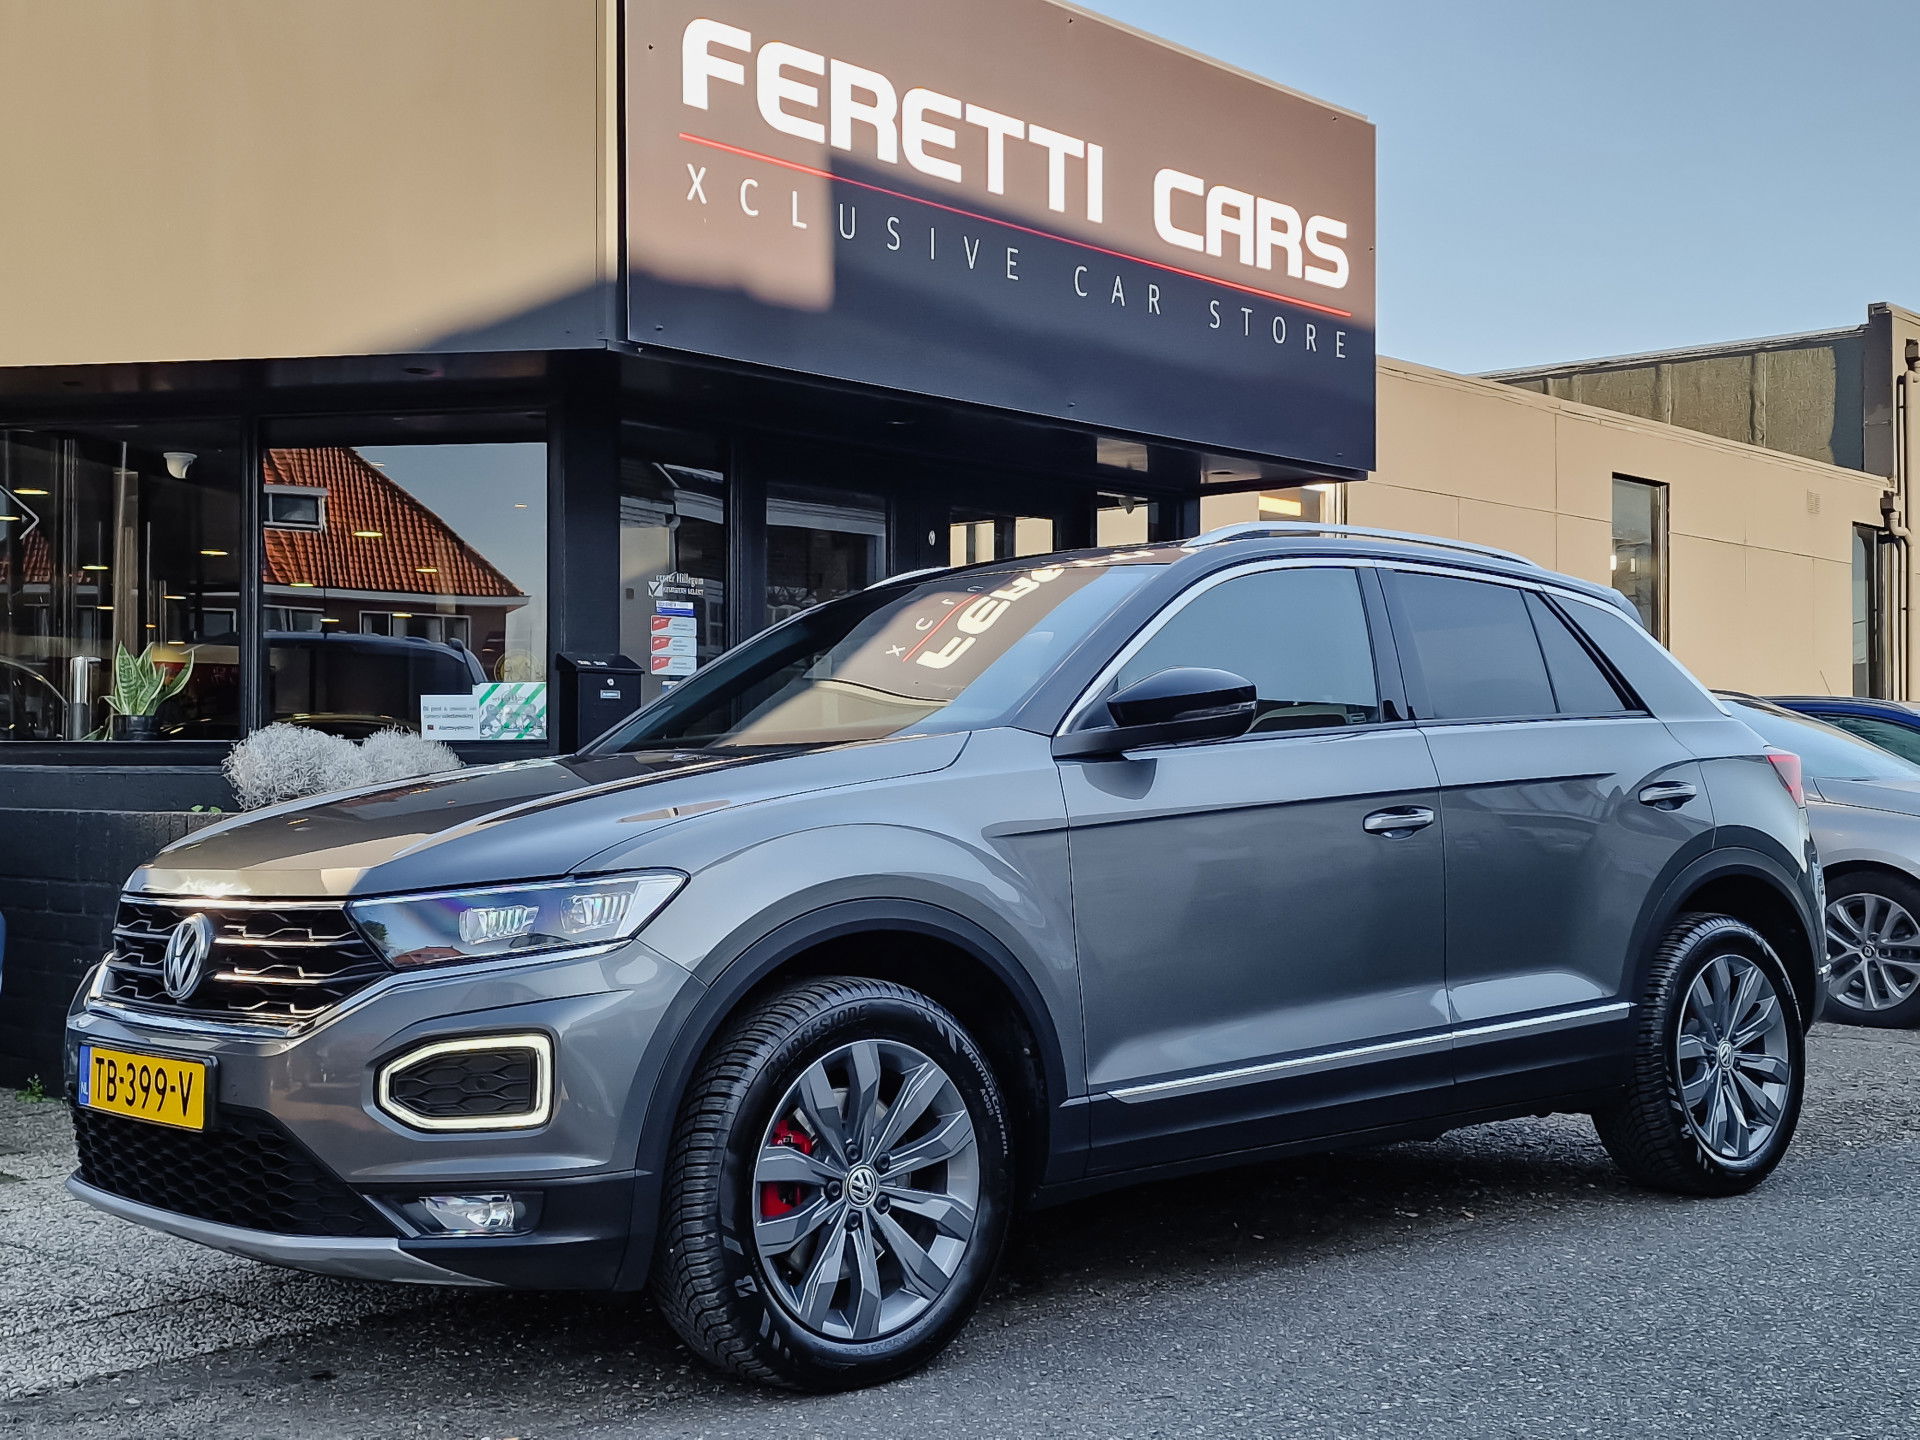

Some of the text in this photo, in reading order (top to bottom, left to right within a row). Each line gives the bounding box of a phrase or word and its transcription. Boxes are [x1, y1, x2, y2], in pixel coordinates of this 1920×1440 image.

[682, 18, 1350, 289] FERETTI CARS
[686, 163, 1347, 359] XCLUSIVE CAR STORE
[80, 1057, 194, 1117] NL TB-399-V
